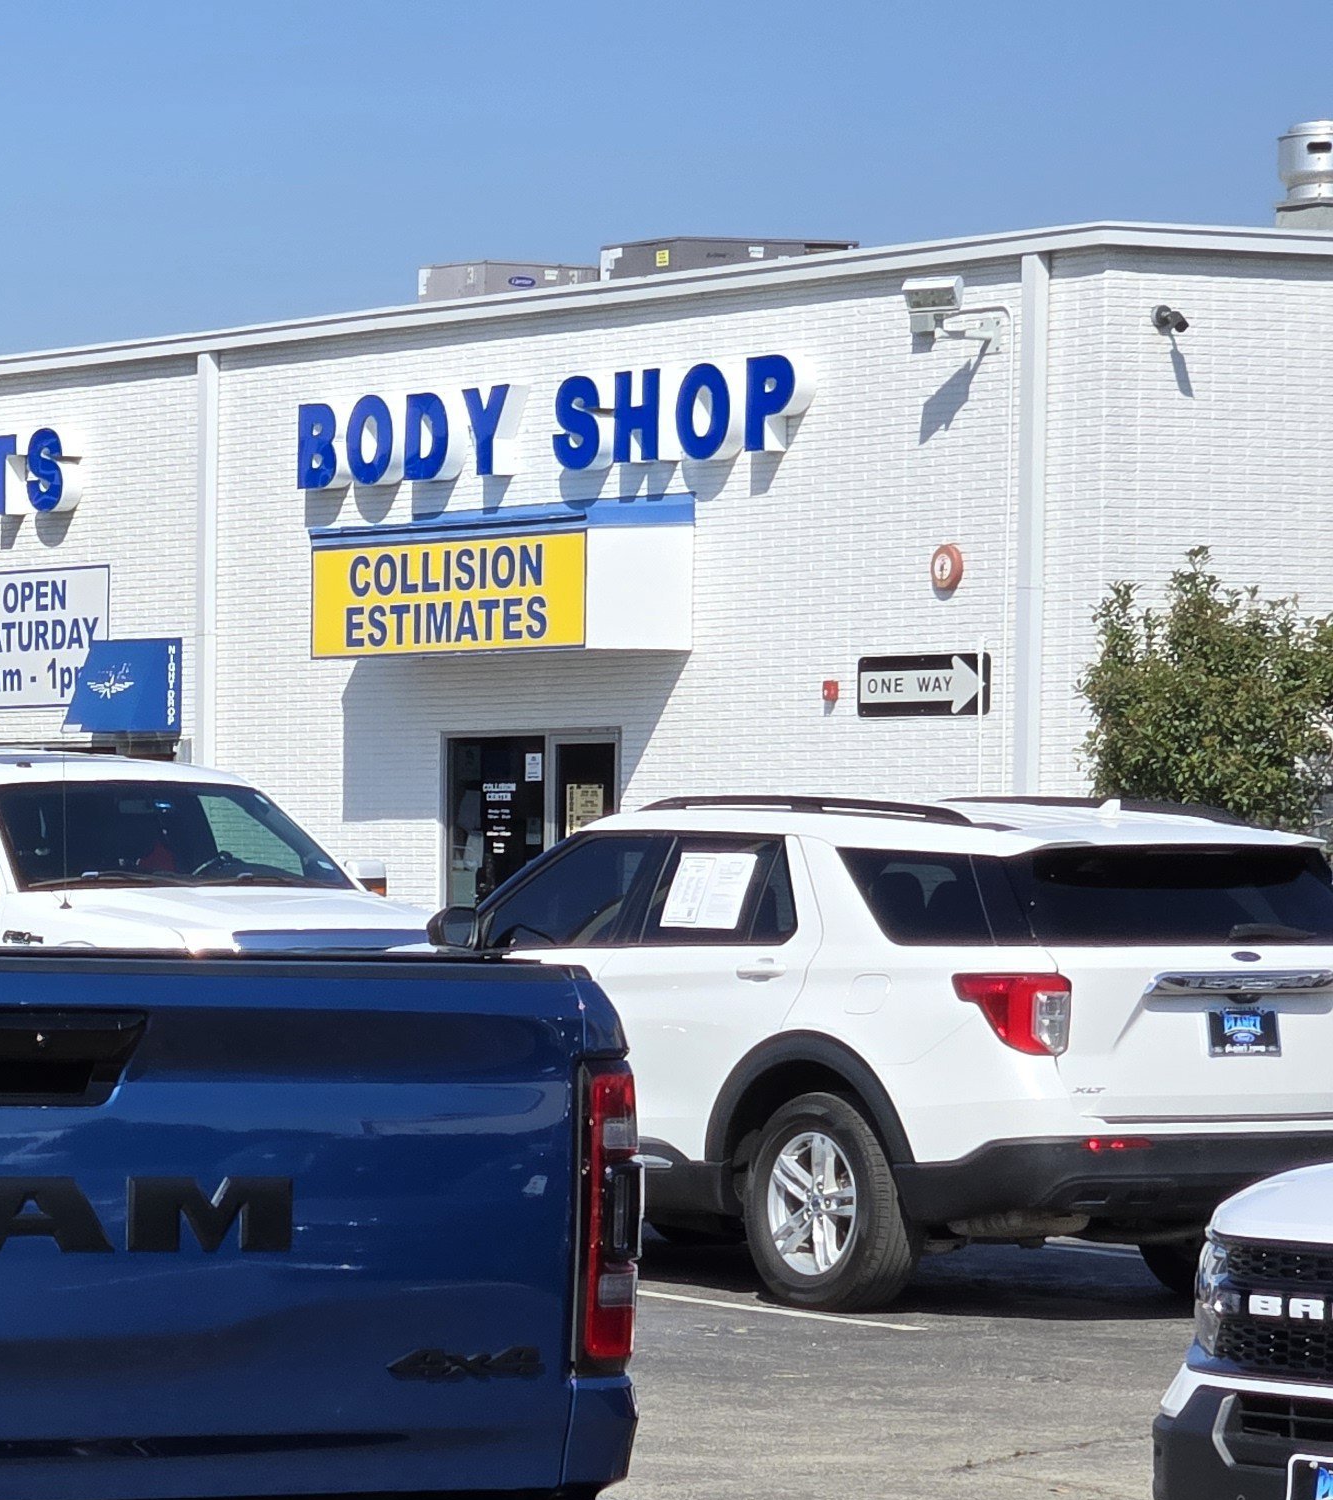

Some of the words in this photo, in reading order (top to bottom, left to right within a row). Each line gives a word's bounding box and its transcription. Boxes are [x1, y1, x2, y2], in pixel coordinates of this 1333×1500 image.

[297, 384, 510, 489] BODY
[552, 354, 795, 470] SHOP
[348, 543, 544, 598] COLLISION
[2, 579, 67, 614] OPEN
[345, 595, 547, 648] ESTIMATES
[867, 677, 904, 694] ONE
[916, 676, 953, 692] WAY
[1248, 1294, 1333, 1320] BR
